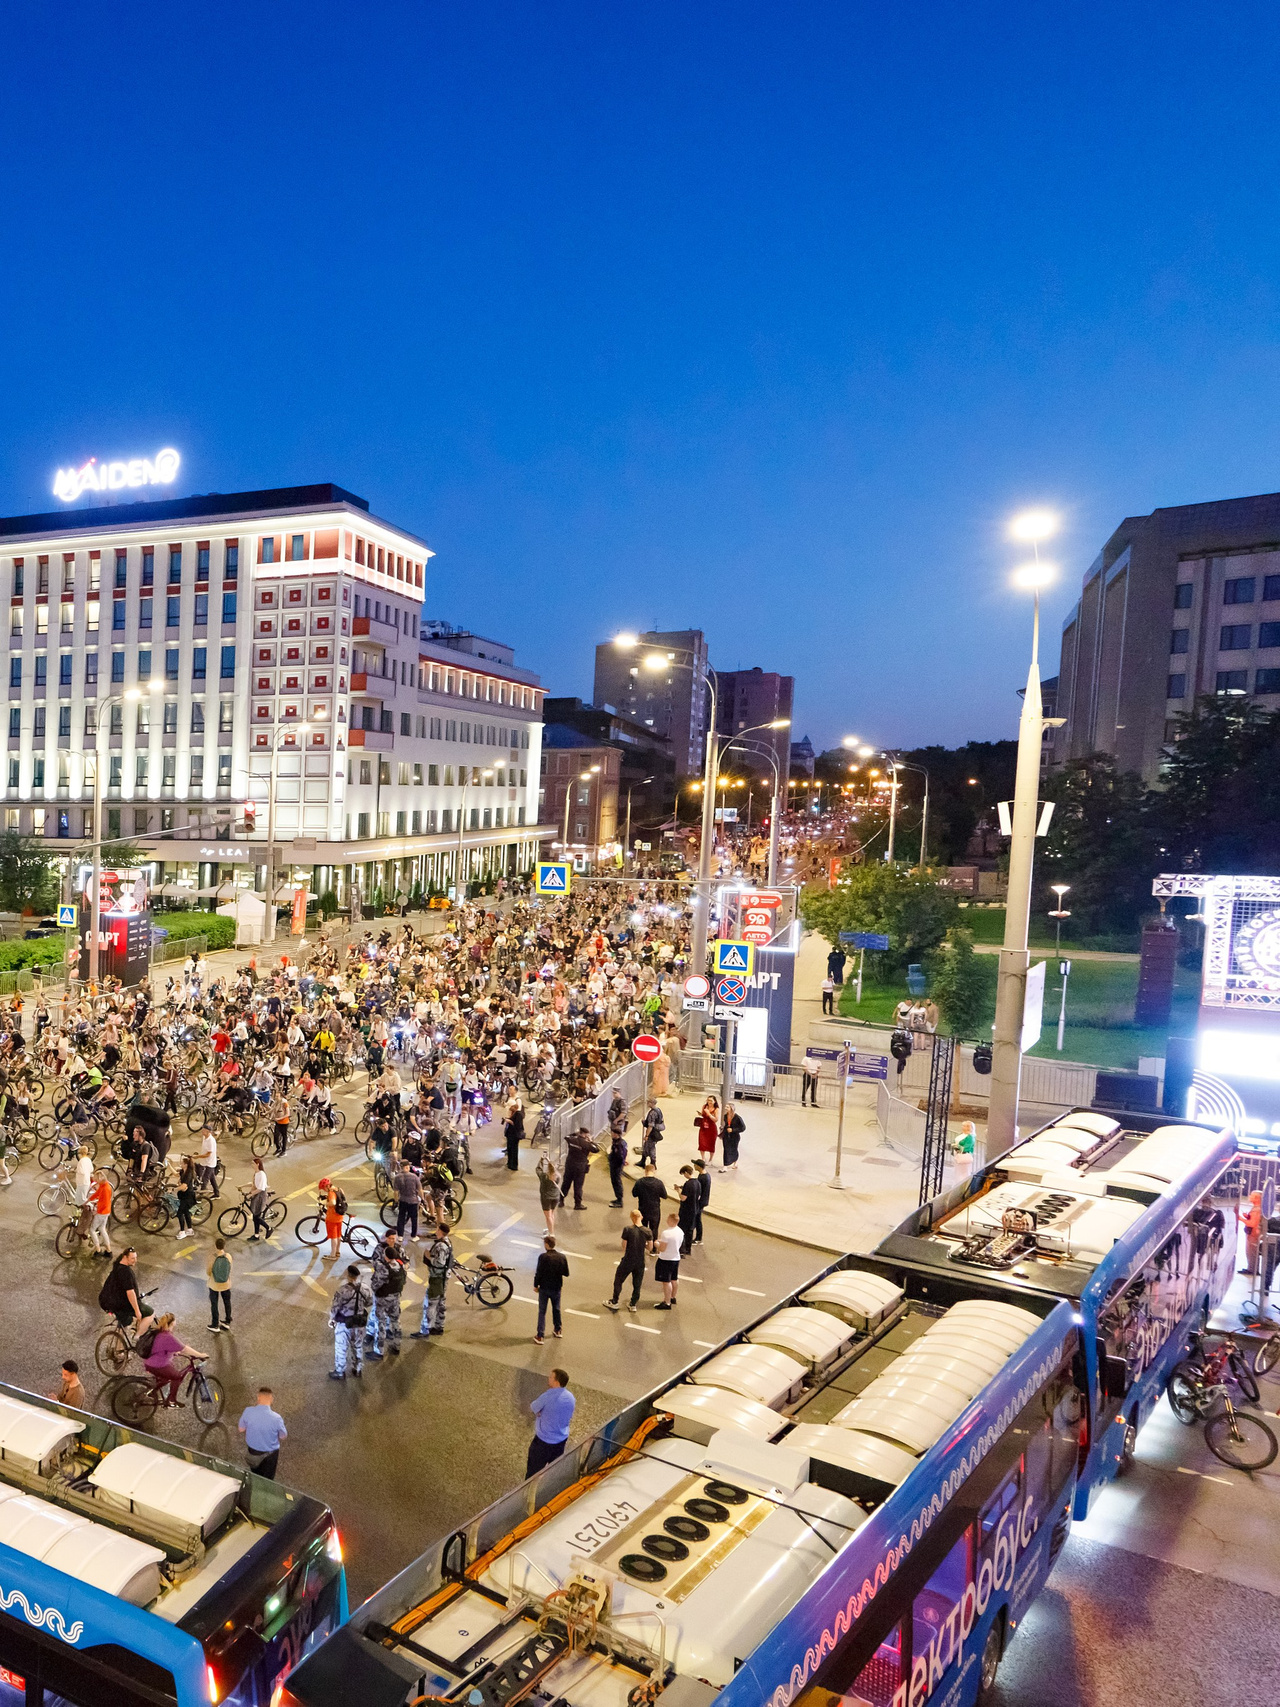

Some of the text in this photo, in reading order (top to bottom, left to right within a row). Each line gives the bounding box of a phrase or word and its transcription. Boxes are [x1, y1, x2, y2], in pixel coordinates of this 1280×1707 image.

[85, 931, 119, 946] САРТ
[726, 972, 781, 990] АРТ
[566, 1501, 638, 1553] 490251
